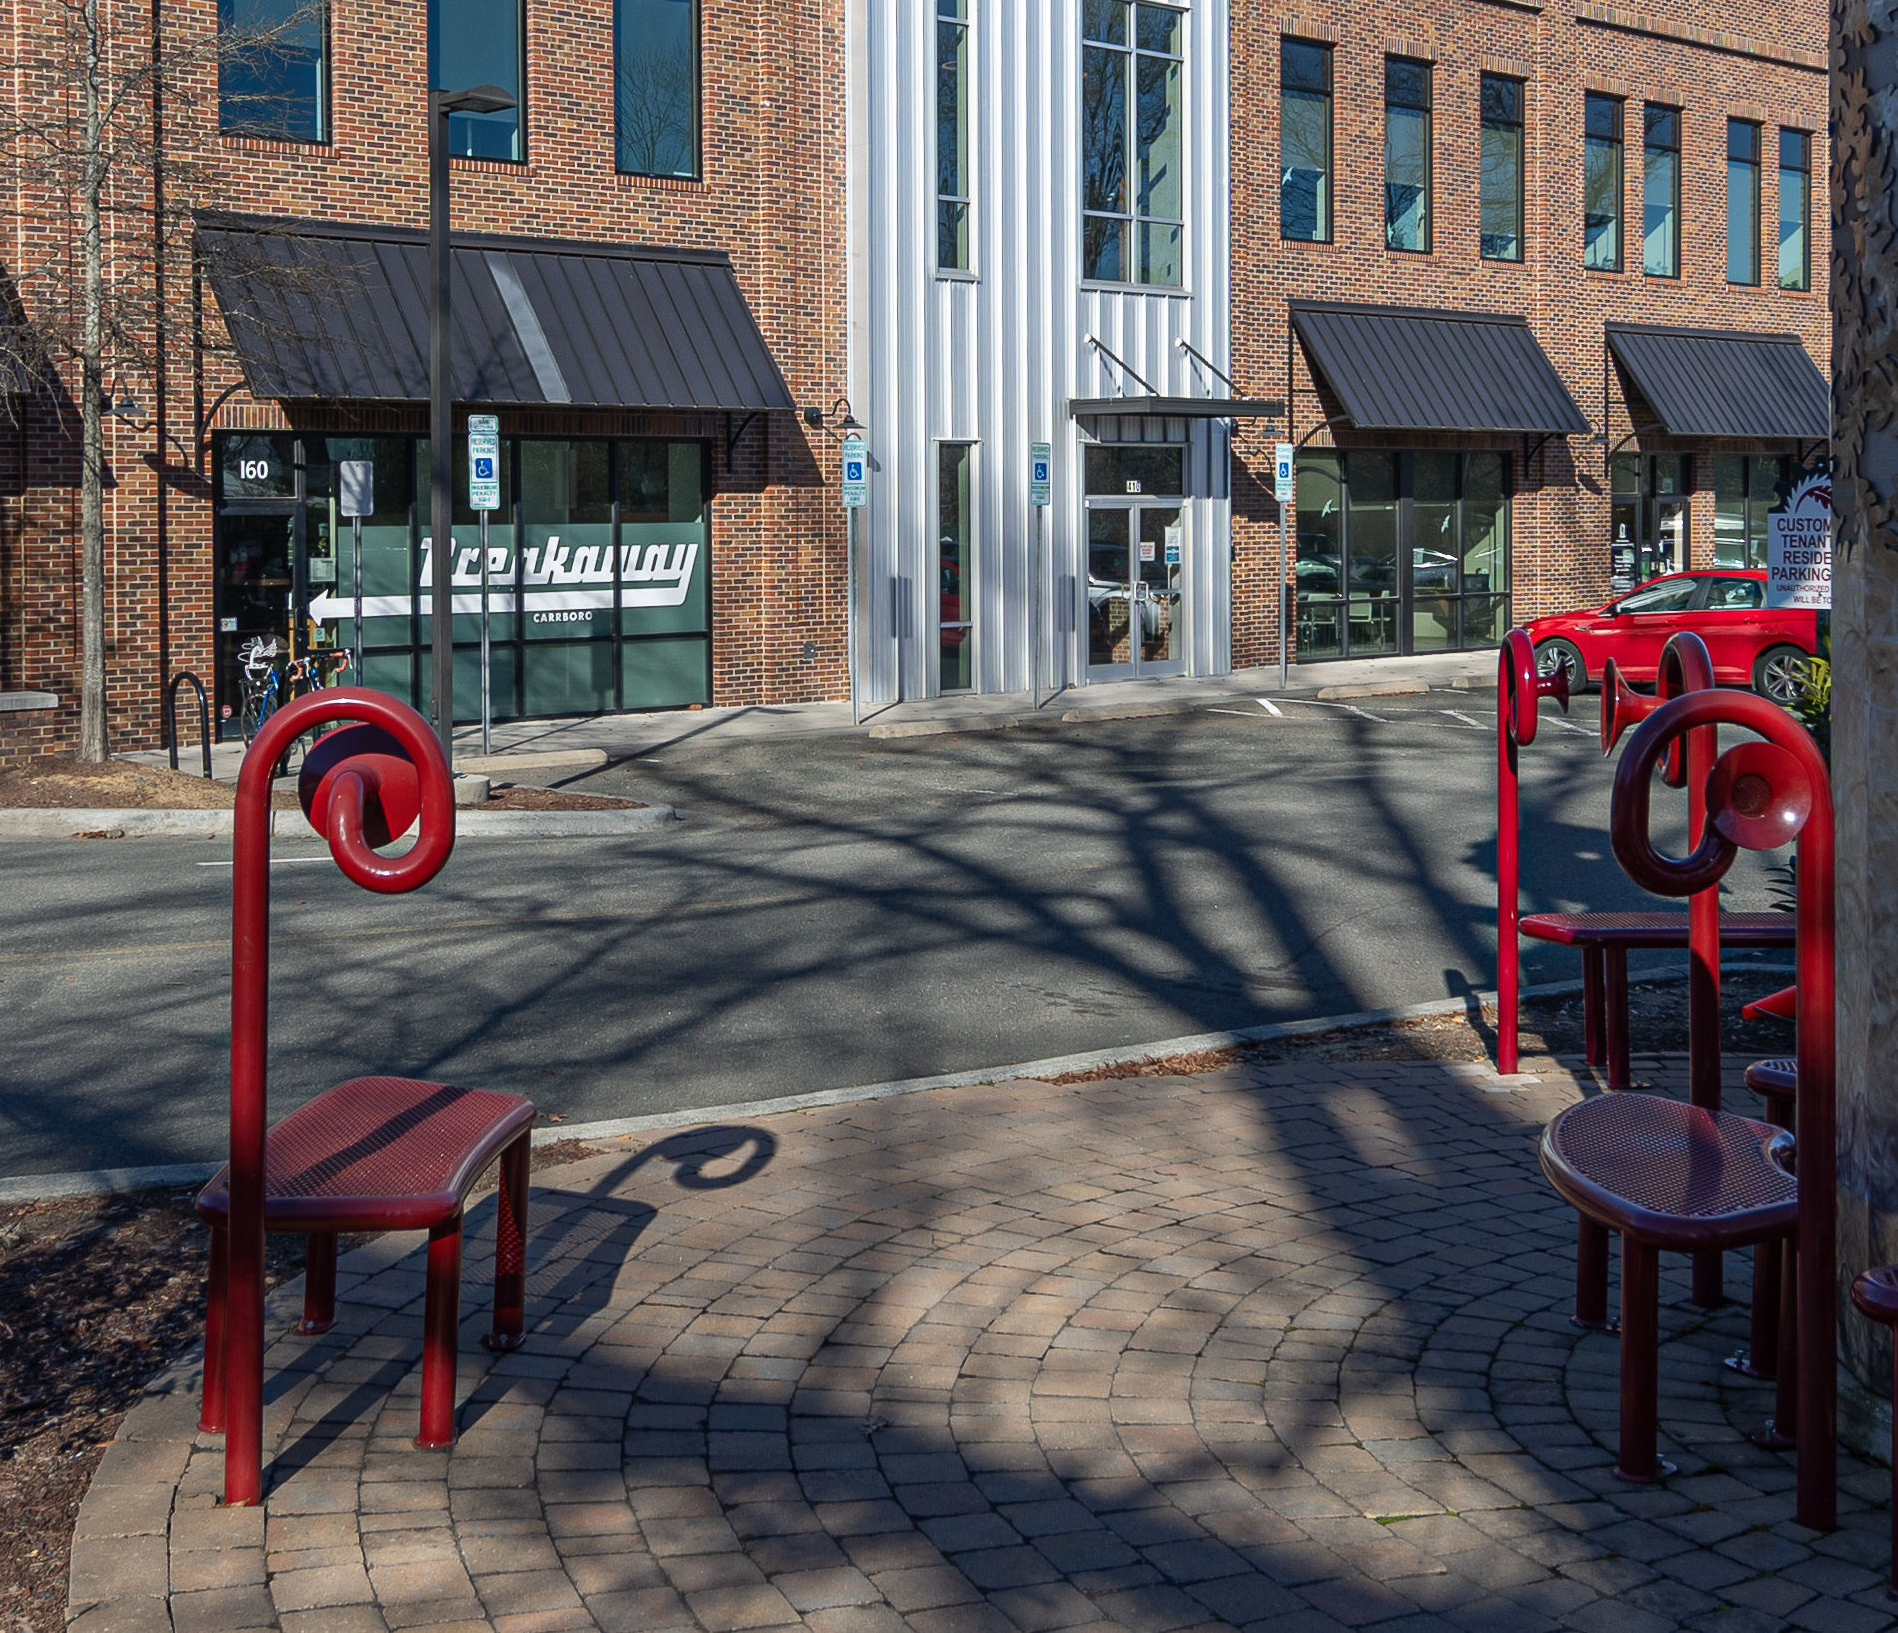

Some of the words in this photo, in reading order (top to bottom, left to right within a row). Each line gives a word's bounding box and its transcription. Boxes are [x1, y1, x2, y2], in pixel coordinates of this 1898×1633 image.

[240, 460, 269, 479] 160
[1772, 567, 1831, 581] PARKING
[1794, 595, 1809, 603] WILL
[533, 610, 593, 623] CARRBORO
